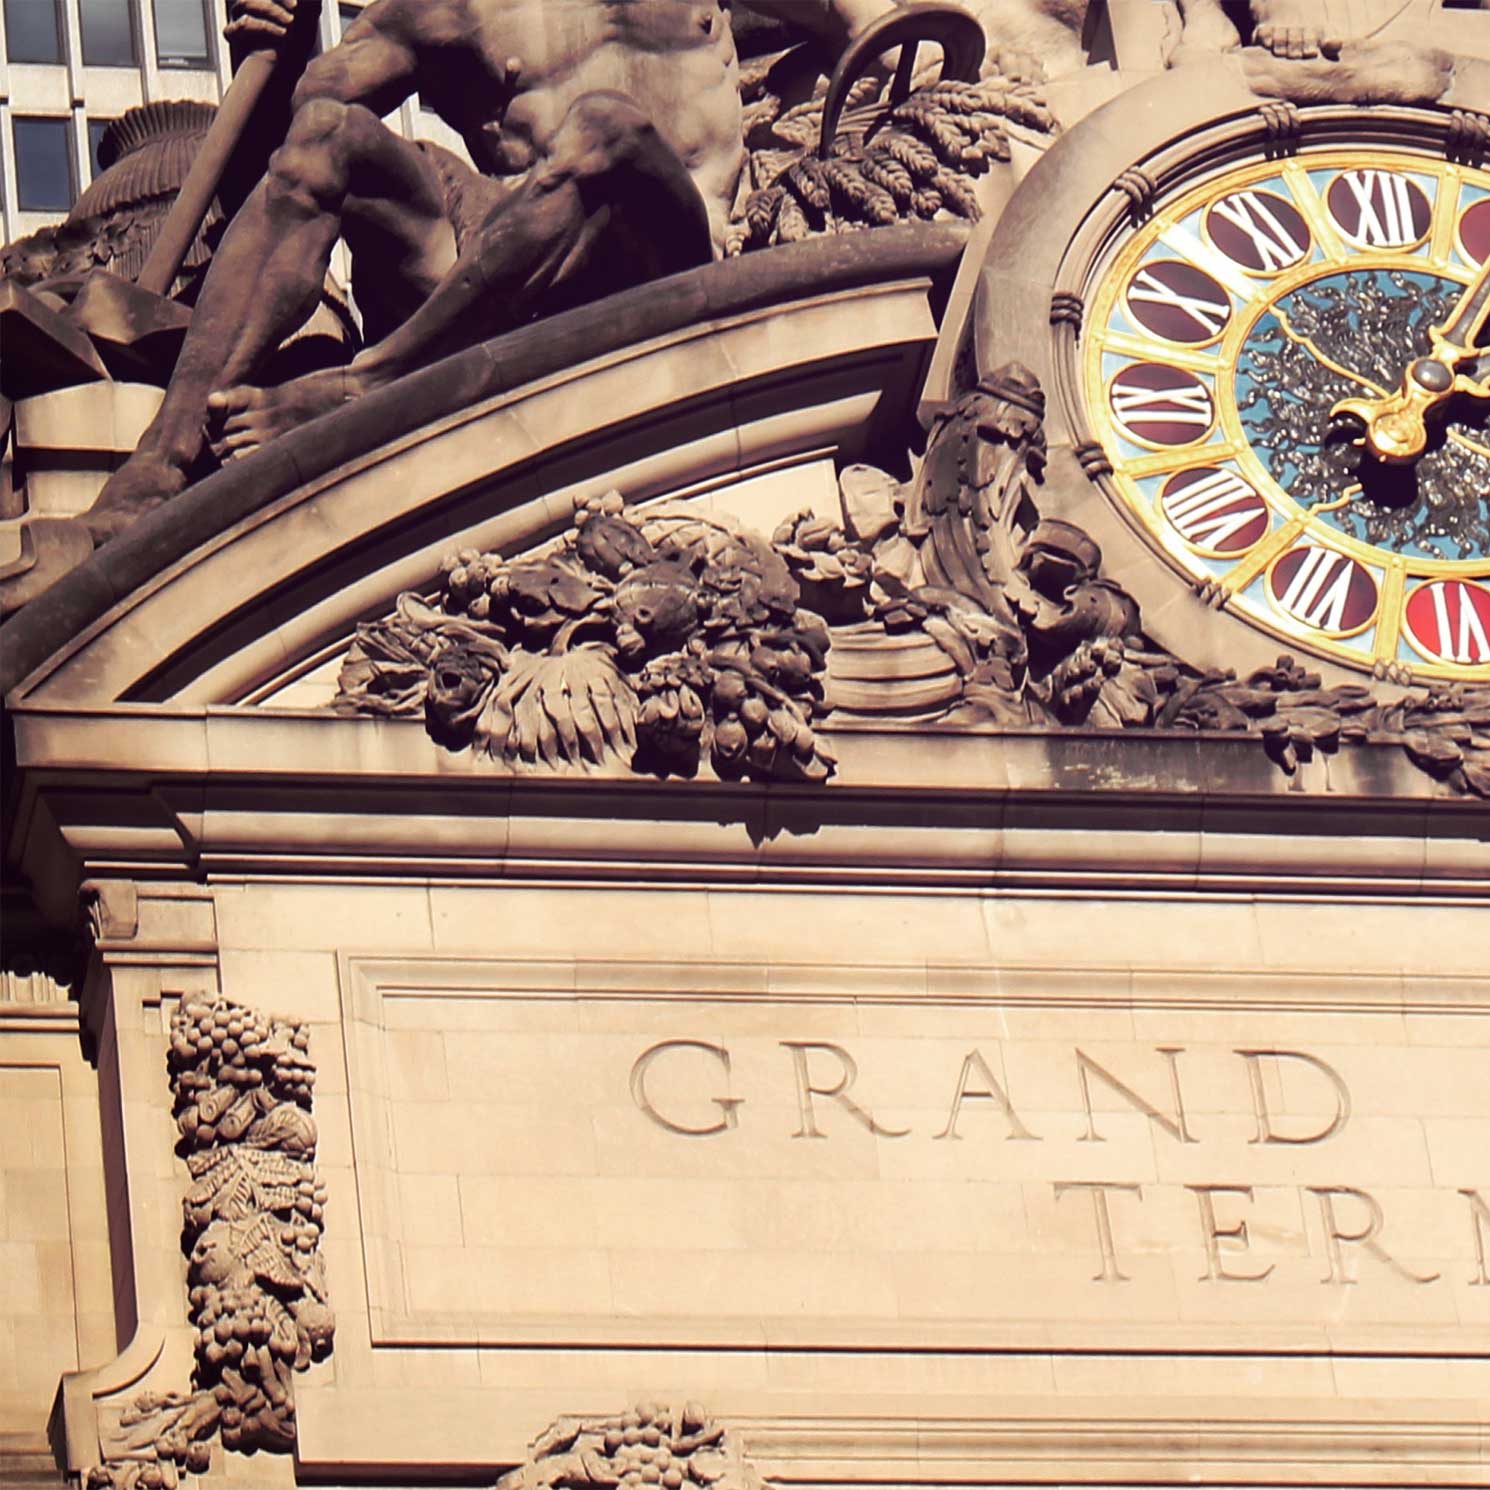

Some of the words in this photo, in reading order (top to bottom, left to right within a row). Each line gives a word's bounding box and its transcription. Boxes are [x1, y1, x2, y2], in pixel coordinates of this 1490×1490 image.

[1211, 191, 1306, 272] XI
[1341, 169, 1420, 247] XII
[1127, 269, 1231, 336] X
[1112, 383, 1212, 426] IX
[1162, 468, 1266, 551] VIII
[1279, 546, 1354, 632] VII
[629, 1039, 1353, 1146] GRAND
